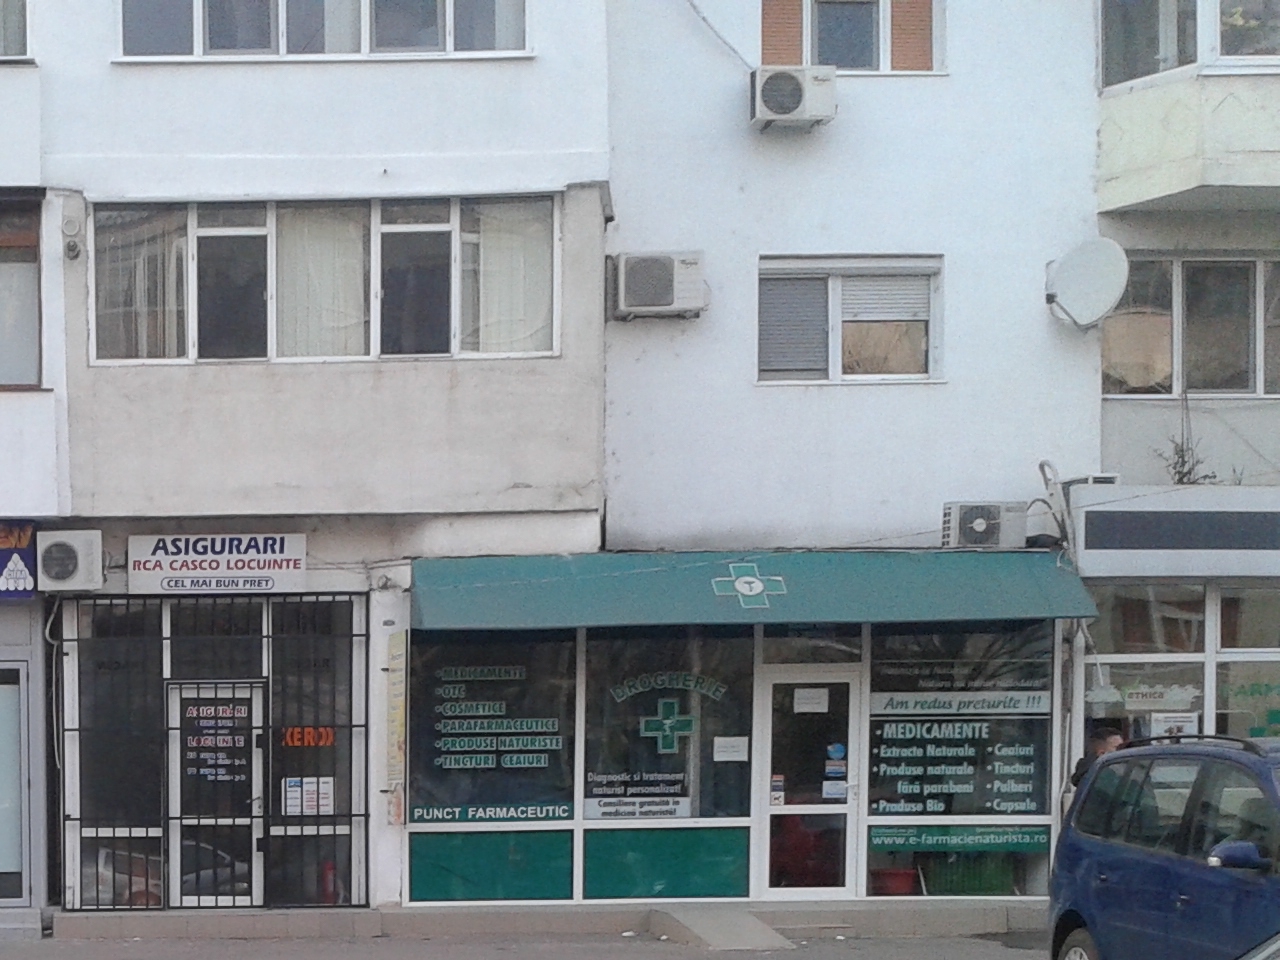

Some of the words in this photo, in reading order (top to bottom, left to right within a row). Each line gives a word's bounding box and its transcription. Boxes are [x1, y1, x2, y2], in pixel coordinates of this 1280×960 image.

[150, 536, 285, 556] ASIGURARI
[132, 559, 164, 571] RCA
[169, 559, 220, 571] CASCO
[226, 558, 302, 571] LOCUINTE
[167, 579, 187, 589] CEL
[190, 579, 212, 588] MAI
[215, 578, 240, 588] BUN
[243, 578, 270, 588] PRET
[442, 666, 526, 680] MEDICAMENTE
[442, 684, 466, 698] OTC
[609, 671, 729, 703] DROGHERIE
[442, 701, 506, 716] COSMETICE
[883, 697, 909, 710] Am
[912, 696, 952, 710] redus
[441, 718, 559, 733] PARAFARMACEUTICE
[883, 722, 990, 740] MEDICAMENTE
[441, 737, 497, 751] PRODUSE
[498, 735, 563, 751] NATURISTE
[879, 744, 923, 757] Extracte
[926, 743, 976, 757] Naturale
[994, 743, 1034, 756] Ceaiuri
[442, 754, 497, 769] TINCTURI
[500, 753, 549, 768] CEAIURI
[879, 762, 924, 776] Produse
[926, 761, 974, 775] naturale
[993, 761, 1035, 774] Tincturi
[923, 780, 974, 796] parabeni
[414, 807, 461, 820] PUNCT
[468, 805, 570, 819] FARMACEUTIC
[878, 799, 923, 812] Produse
[926, 799, 946, 811] Bio
[993, 799, 1037, 813] Capsule
[871, 831, 1048, 846] www.e-farmacienaturista.ro
